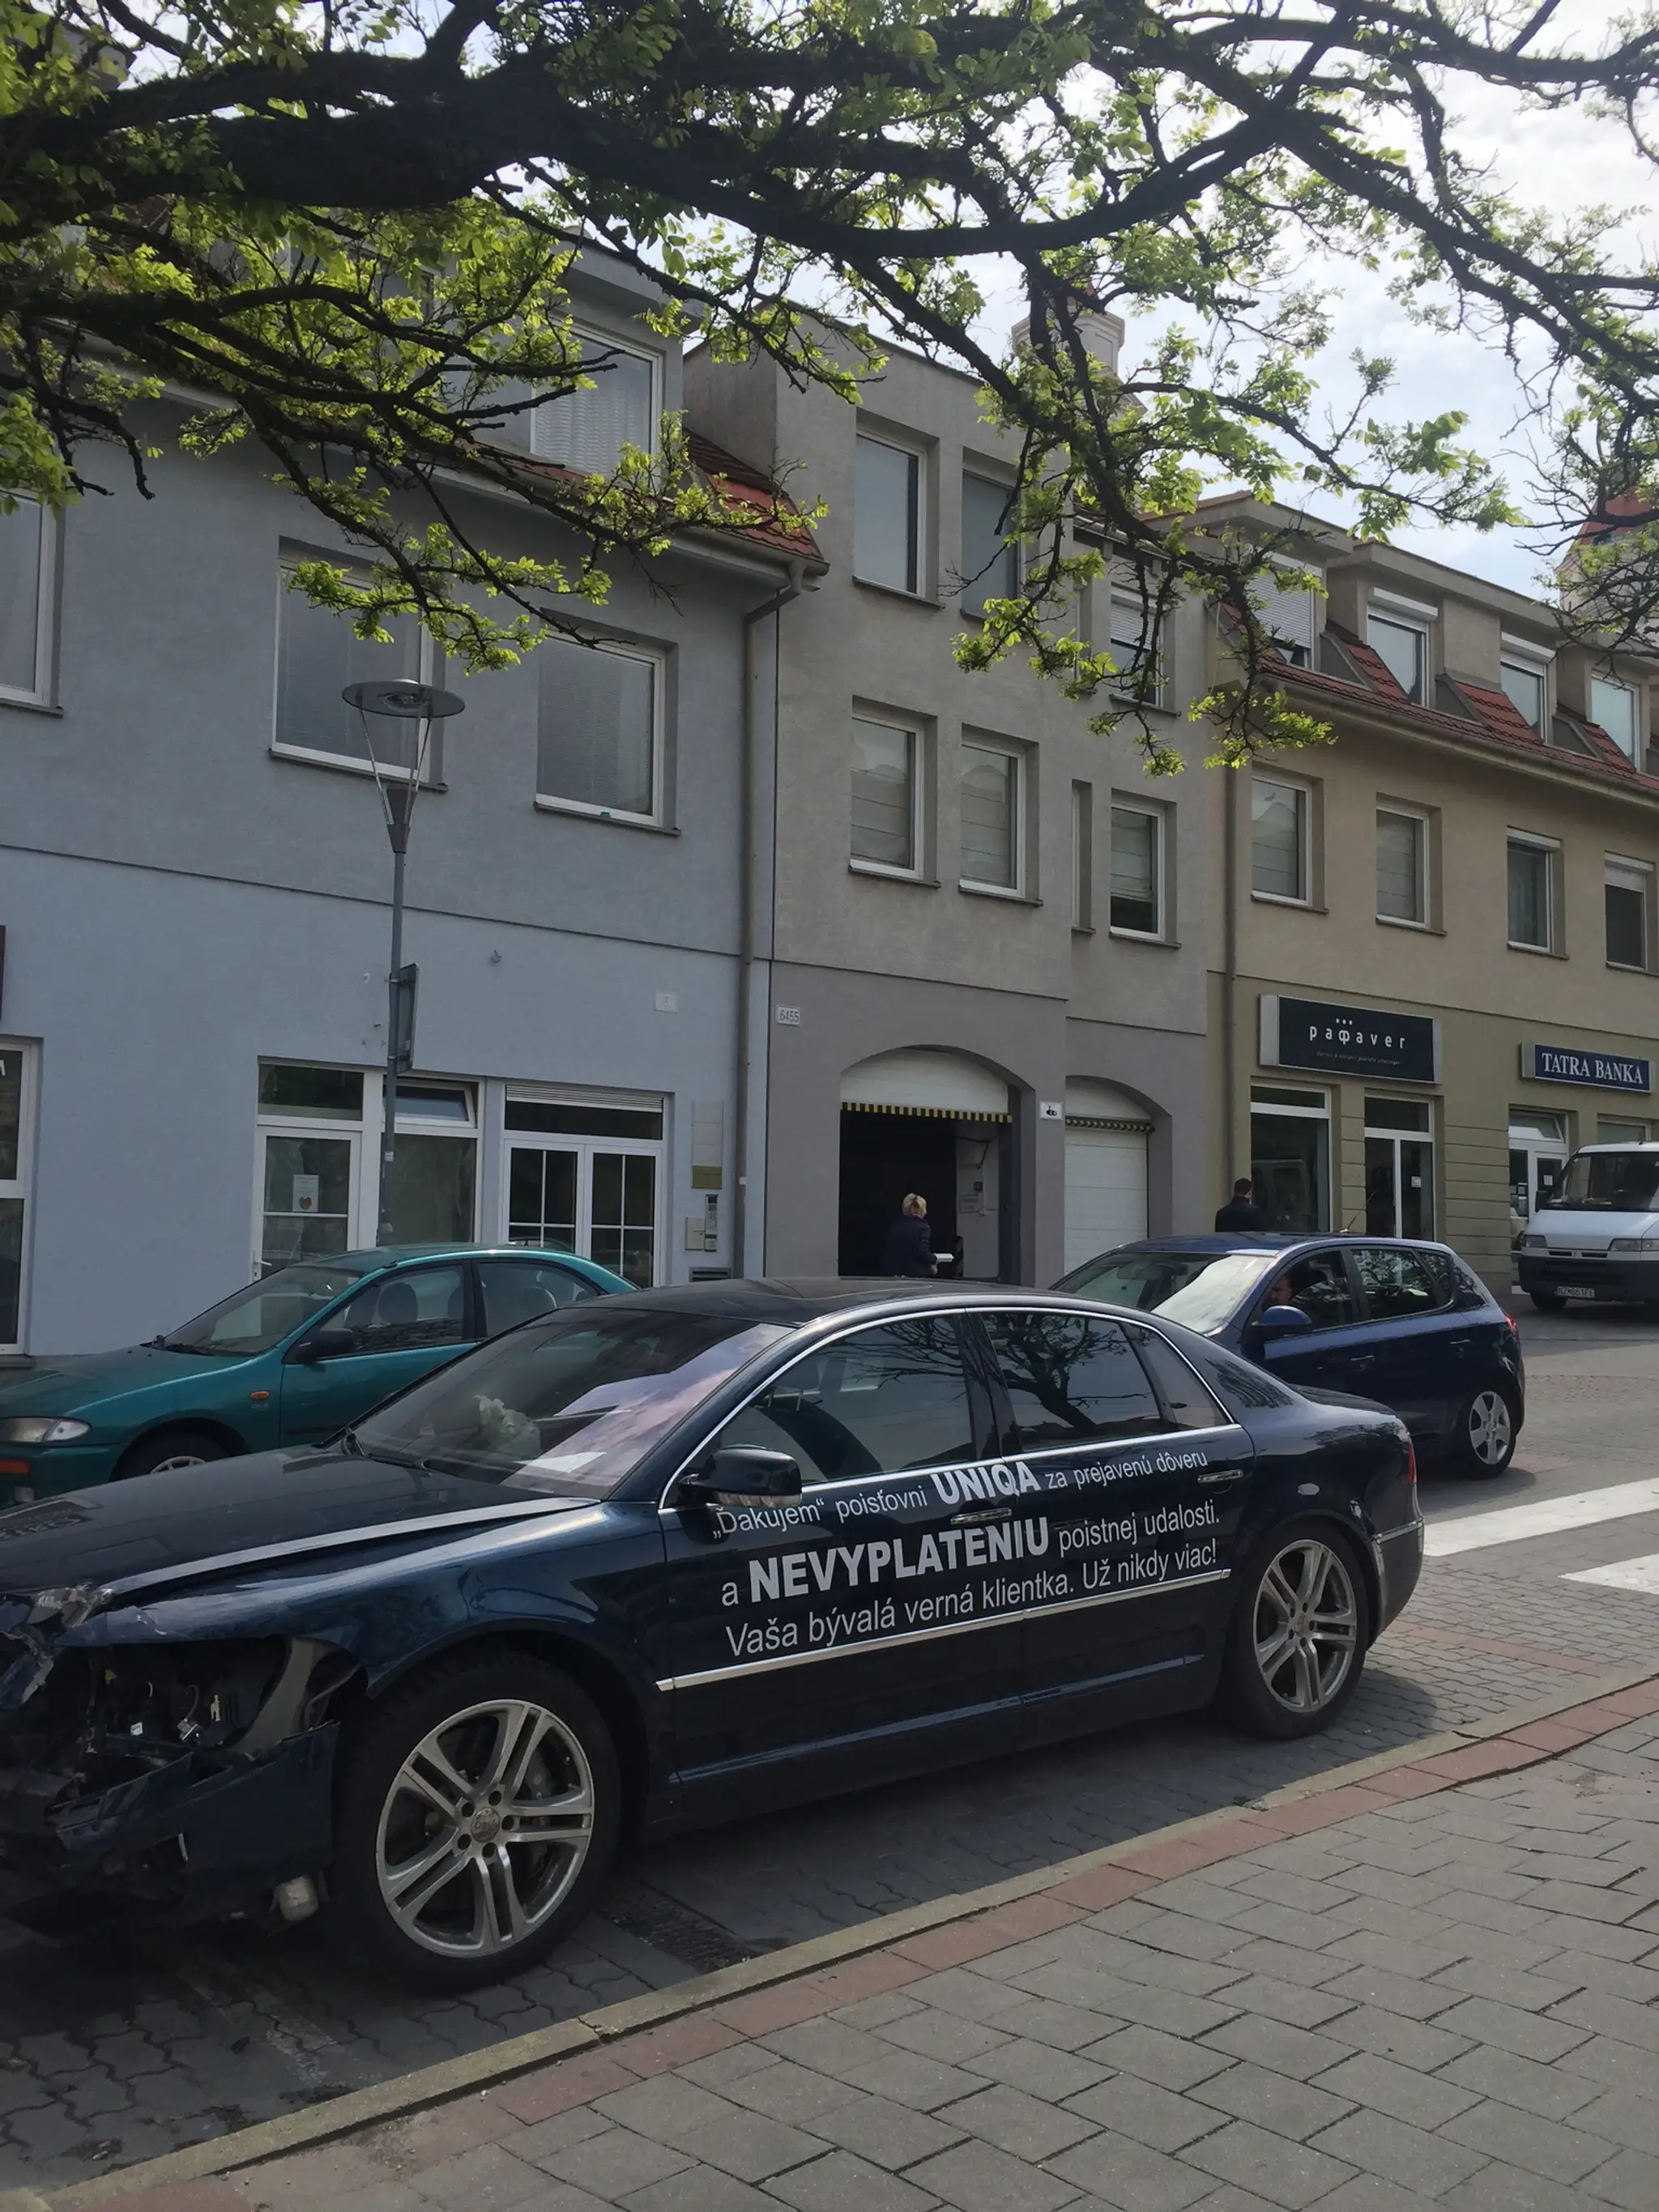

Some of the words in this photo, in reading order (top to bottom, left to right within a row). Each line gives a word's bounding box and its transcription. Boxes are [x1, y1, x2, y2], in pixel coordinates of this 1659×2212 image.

[1542, 1052, 1591, 1077] TATRA
[1594, 1059, 1643, 1085] BANKA
[835, 1485, 928, 1523] poisťovni
[930, 1460, 1041, 1504] UNIQA
[1044, 1471, 1068, 1490] za
[1073, 1459, 1154, 1490] prejavenú
[1156, 1451, 1208, 1473] dôveru
[721, 1581, 739, 1606] a
[748, 1516, 1049, 1603] NEVYPLATENIU
[1059, 1511, 1137, 1558] poistnej
[1145, 1498, 1219, 1536] udalosti.
[726, 1617, 798, 1656] Vaša
[809, 1597, 896, 1647] bývalá
[904, 1583, 974, 1623] verná
[983, 1569, 1074, 1609] klientka.
[1082, 1559, 1111, 1589] Už
[1118, 1549, 1169, 1582] nikdy
[1175, 1537, 1217, 1571] viac!
